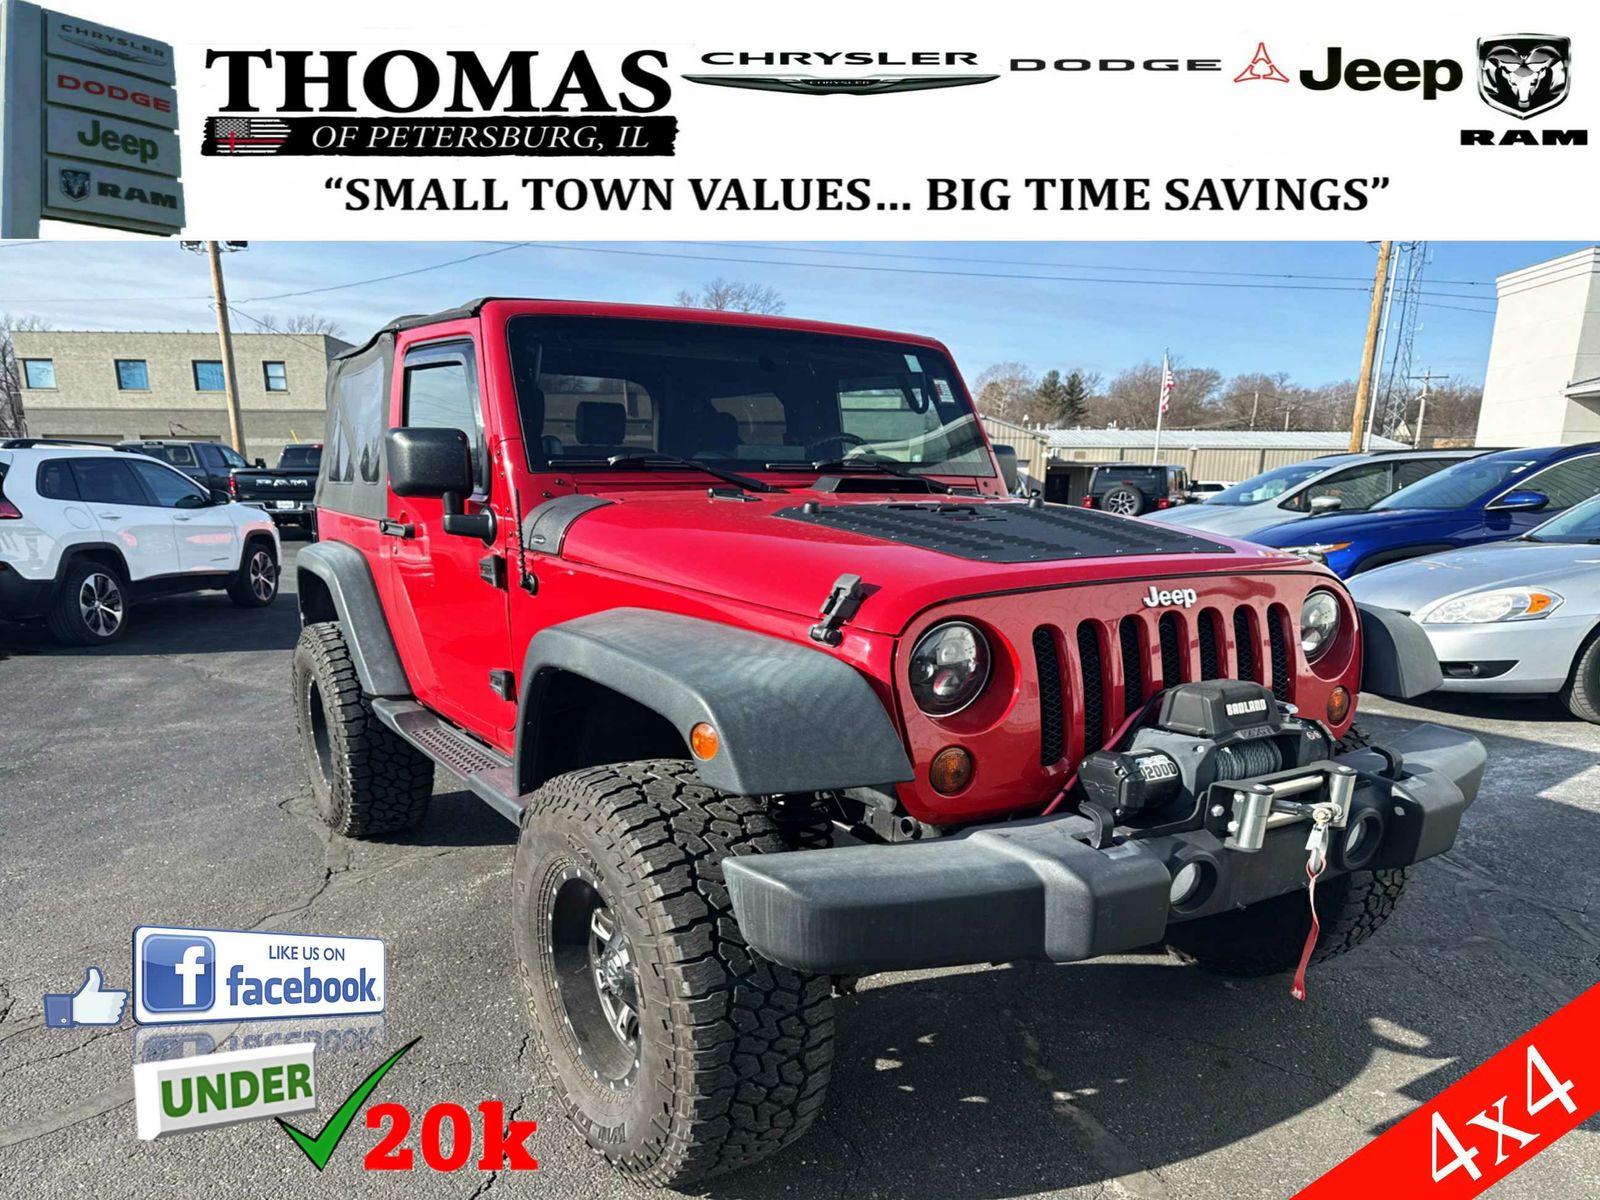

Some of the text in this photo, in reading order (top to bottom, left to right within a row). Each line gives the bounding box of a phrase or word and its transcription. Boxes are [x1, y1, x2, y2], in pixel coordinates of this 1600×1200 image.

[256, 479, 308, 487] RAM
[1144, 586, 1197, 608] Jeep
[1226, 699, 1267, 716] BADLAND
